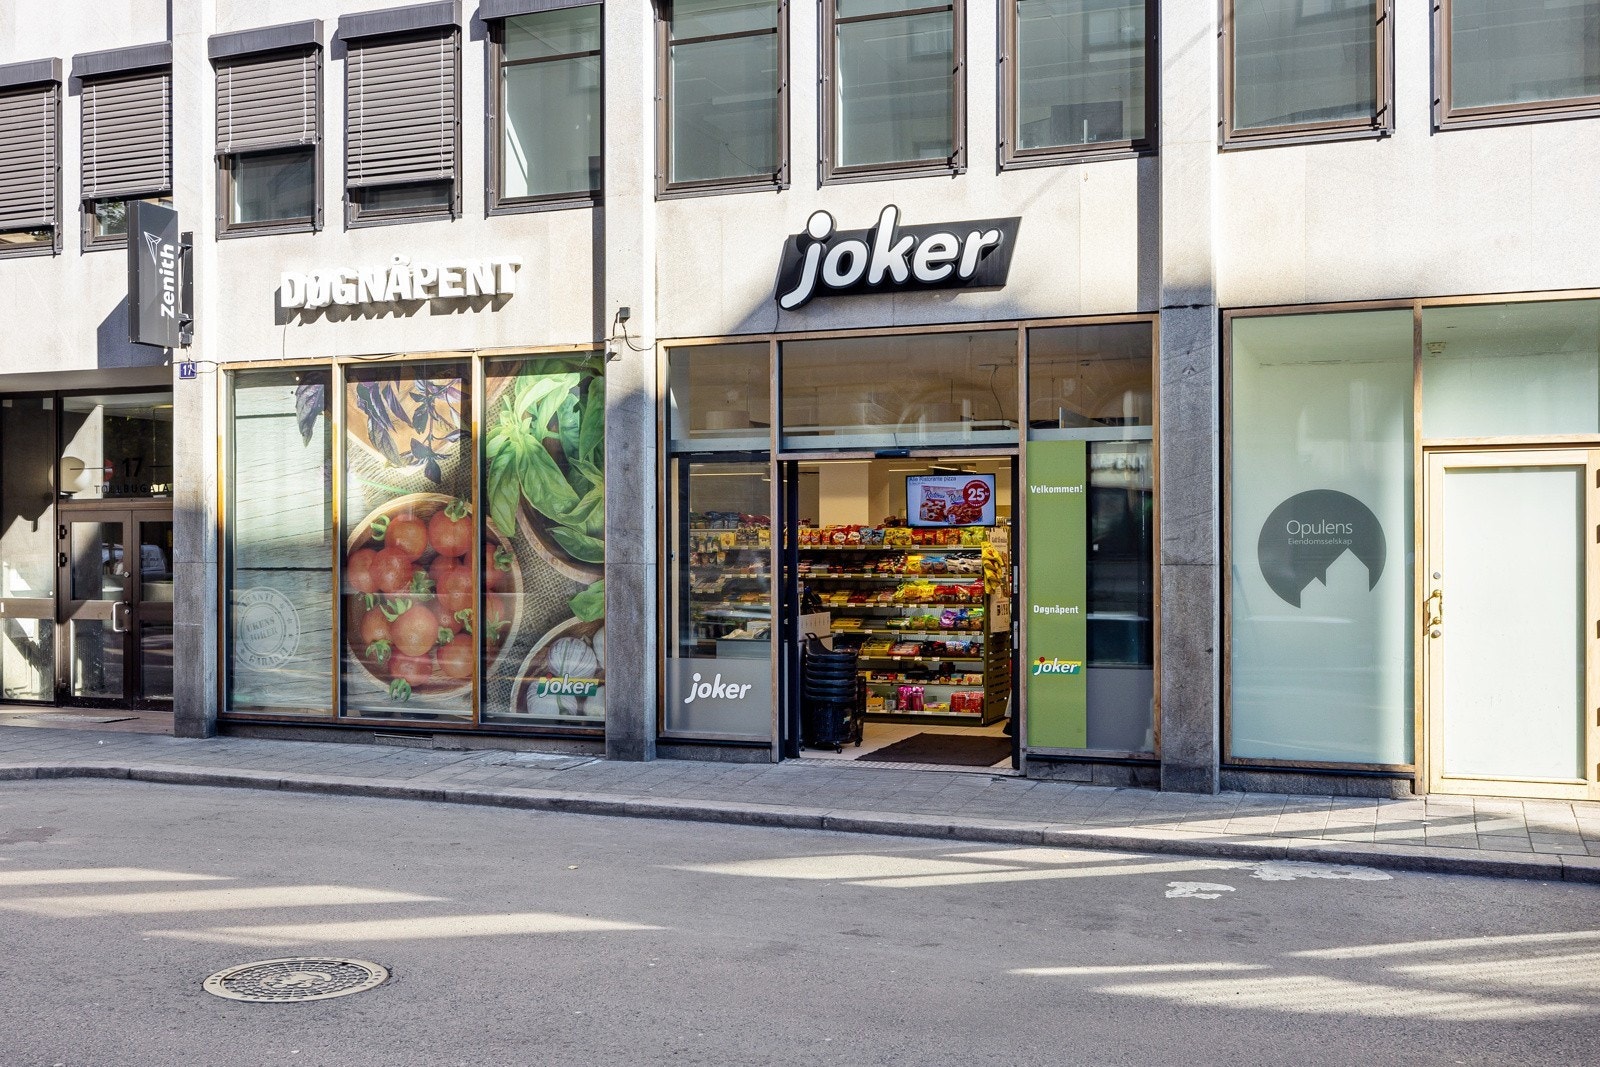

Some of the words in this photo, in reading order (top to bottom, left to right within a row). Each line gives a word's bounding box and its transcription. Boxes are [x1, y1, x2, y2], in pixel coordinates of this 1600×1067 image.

[780, 204, 1004, 310] joker
[159, 243, 175, 319] Zenith
[281, 253, 523, 309] DØGNÅPENT
[122, 457, 143, 477] 17
[968, 488, 986, 501] 25
[1030, 484, 1083, 493] Velkommen!
[1286, 518, 1353, 539] Opulens
[1287, 537, 1353, 547] Eiendomsselskap
[1033, 604, 1079, 615] Døgnåpent
[1033, 656, 1078, 676] joker
[539, 673, 598, 698] joker
[684, 672, 752, 704] joker
